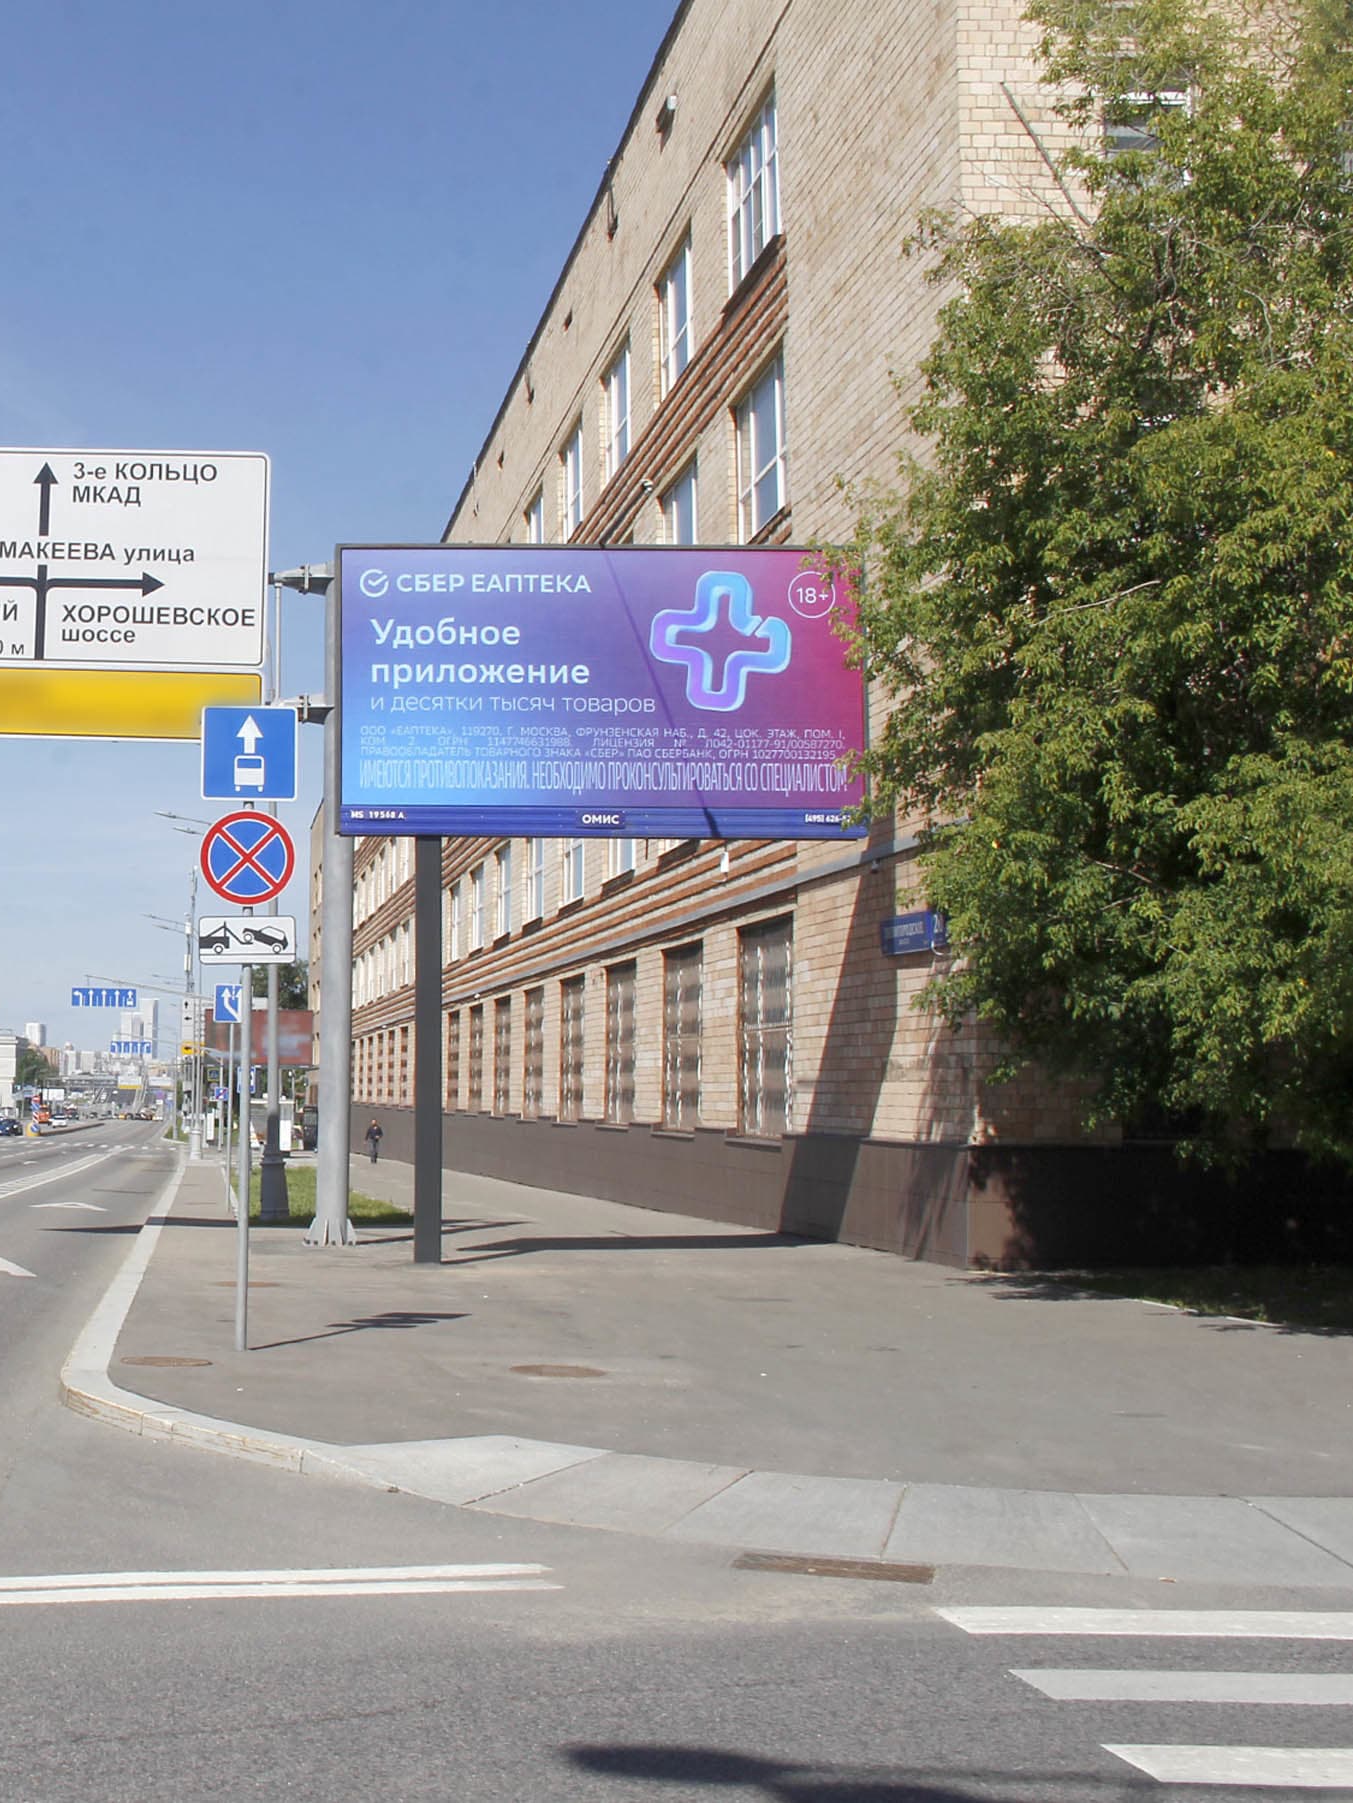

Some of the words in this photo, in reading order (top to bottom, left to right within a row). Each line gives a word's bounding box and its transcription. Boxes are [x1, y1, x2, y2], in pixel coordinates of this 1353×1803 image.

[74, 463, 106, 479] 3-е
[116, 463, 217, 484] КОЛЬЦО
[73, 486, 140, 506] МКАД
[0, 542, 115, 560] МАКЕЕВА
[124, 549, 193, 565] улица
[396, 573, 464, 593] СБЕР
[472, 574, 592, 593] ЕАПТЕКА
[796, 588, 828, 604] 18+
[63, 605, 254, 626] ХОРОШЕВСКОЕ
[62, 629, 135, 643] шоссе
[370, 617, 521, 649] Удобное
[12, 644, 24, 654] м
[370, 663, 590, 689] приложение
[371, 697, 384, 711] и
[390, 696, 483, 713] десятки
[489, 697, 556, 712] тысяч
[562, 697, 656, 717] товаров
[359, 726, 386, 736] ООО
[575, 727, 659, 738] ФРУНЗЕНСКАЯ
[359, 746, 472, 757] ПРАВООБЛАДАТЕЛЬ
[474, 747, 542, 758] ТОВАРНОГО
[543, 748, 581, 758] ЗНАКА
[627, 748, 652, 759] ПАО
[718, 749, 749, 759] ОГРН
[593, 738, 655, 748] ЛИЦЕНЗИЯ
[359, 760, 411, 788] ИМЕЮТСЯ
[532, 761, 605, 796] НЕОБХОДИМО
[608, 762, 743, 790] ПРОКОНСУЛЬТИРОВАТЬСЯ
[745, 763, 758, 790] СО
[582, 814, 620, 825] ОМИС
